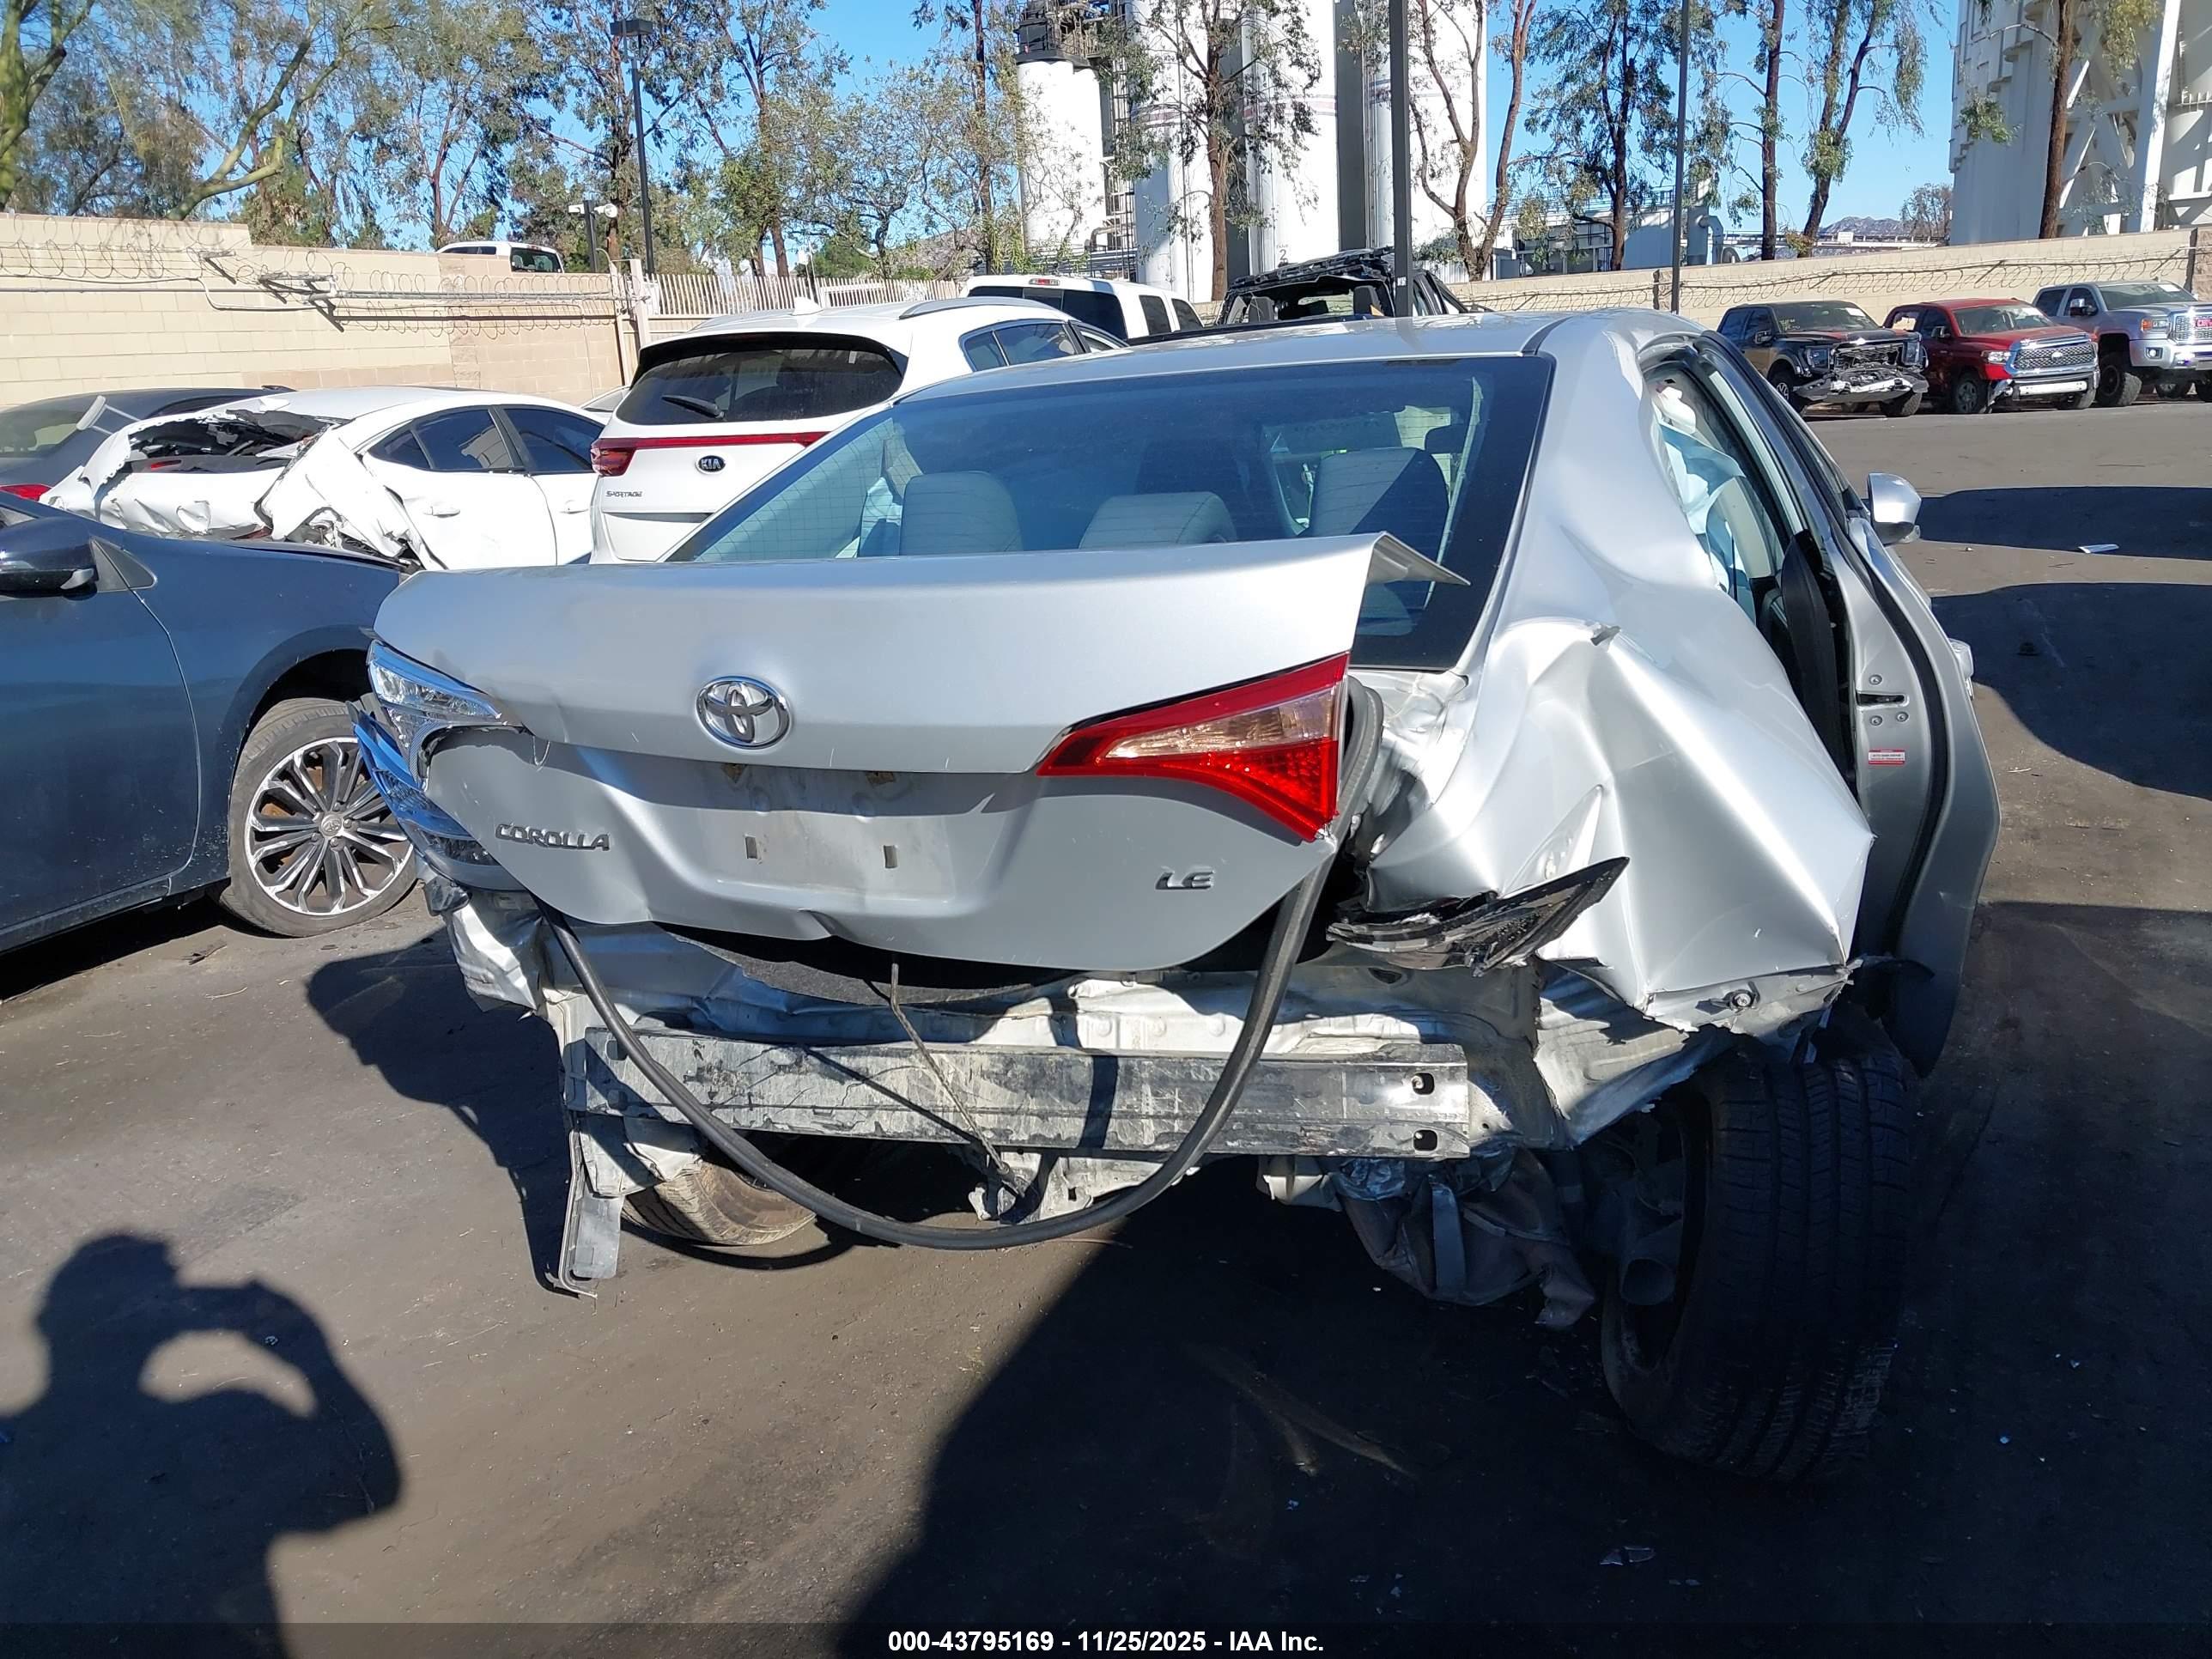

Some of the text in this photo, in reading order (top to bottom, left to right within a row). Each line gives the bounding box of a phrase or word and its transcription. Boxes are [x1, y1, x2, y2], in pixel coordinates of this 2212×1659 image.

[700, 458, 722, 471] KIA
[495, 823, 611, 852] COROLLA
[1154, 870, 1214, 890] LE
